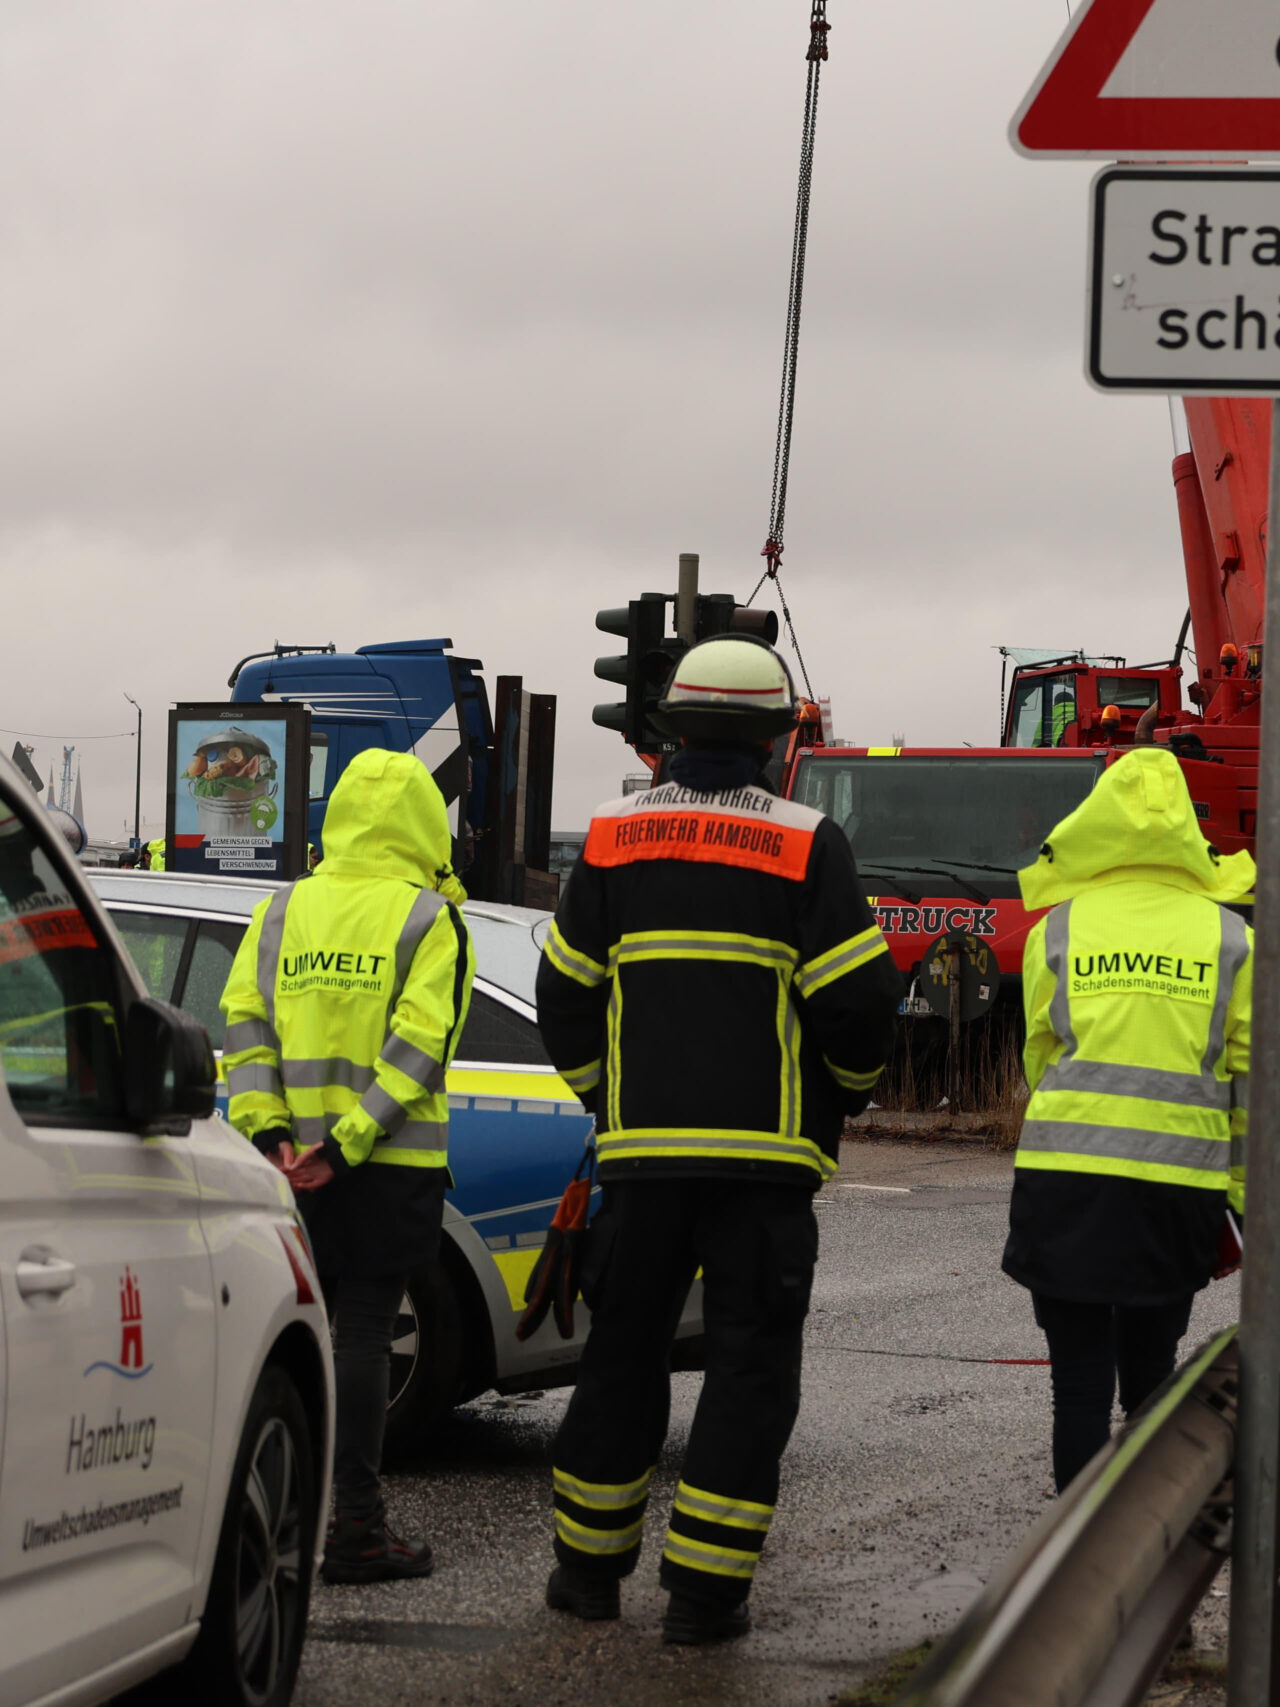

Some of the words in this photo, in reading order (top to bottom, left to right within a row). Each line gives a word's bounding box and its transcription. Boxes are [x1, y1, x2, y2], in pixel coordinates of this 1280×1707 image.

[615, 817, 700, 848] FEUERWEHR
[703, 820, 784, 858] HAMBURG
[871, 906, 997, 935] TRUCK
[1074, 952, 1214, 983] UMWELT
[1073, 976, 1210, 999] Schadensmanagement
[65, 1406, 157, 1475] Hamburg
[22, 1481, 184, 1552] Umweltschadensmanagement
